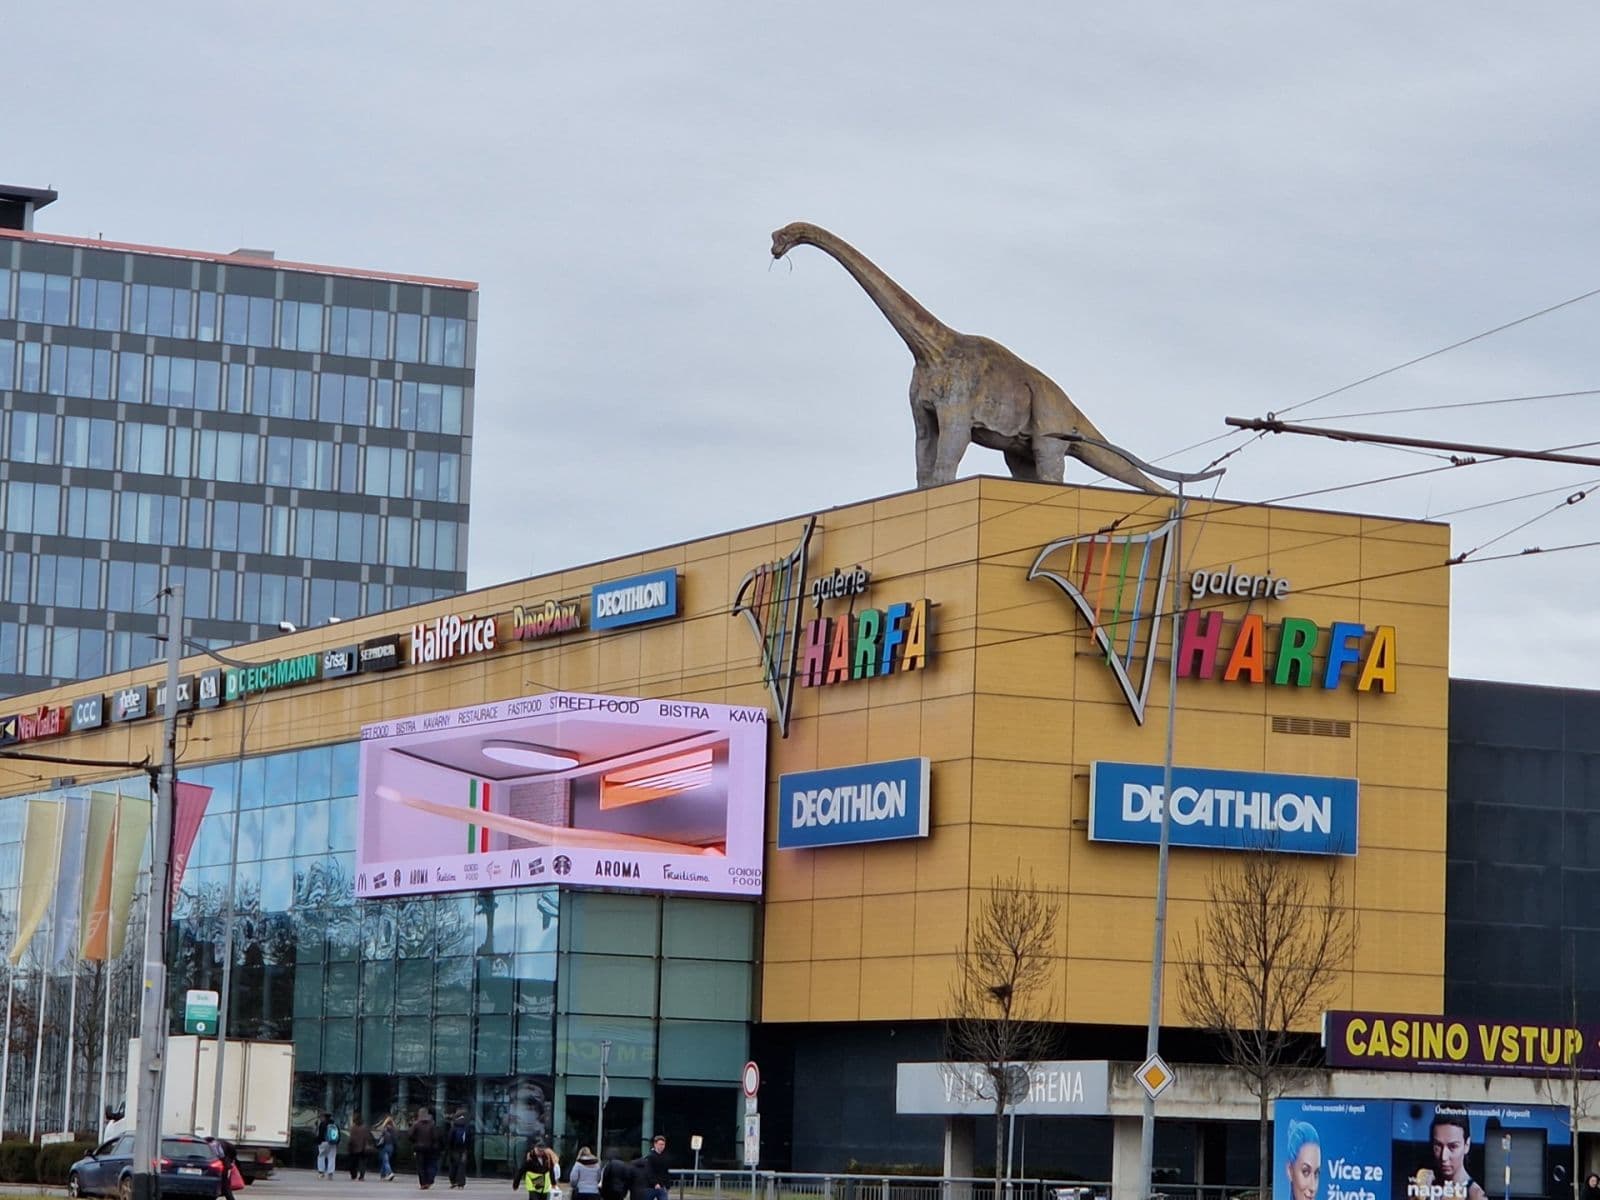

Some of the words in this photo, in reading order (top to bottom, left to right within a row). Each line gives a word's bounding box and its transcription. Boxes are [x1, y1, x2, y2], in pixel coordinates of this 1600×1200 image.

[597, 581, 667, 618] DECATHLON
[811, 567, 867, 608] galerie
[1192, 566, 1290, 599] galerie
[410, 614, 496, 664] HalfPrice
[802, 599, 927, 687] HARFA
[1177, 609, 1396, 694] HARFA
[76, 701, 97, 724] CCC
[396, 721, 416, 735] BISTRA
[458, 706, 498, 723] RESTAURACE
[508, 699, 542, 716] FASTFOOD
[550, 696, 595, 710] STREET
[599, 700, 640, 714] FOOD
[659, 704, 710, 719] BISTRA
[729, 708, 765, 724] KAVÁ
[792, 779, 907, 829] DECATHLON
[1121, 783, 1332, 834] DECATHLON
[595, 859, 640, 878] AROMA
[732, 877, 761, 887] FOOD
[1346, 1018, 1469, 1061] CASINO
[1478, 1024, 1584, 1065] VSTUP
[1327, 1158, 1361, 1180] Více
[1364, 1165, 1384, 1181] ze
